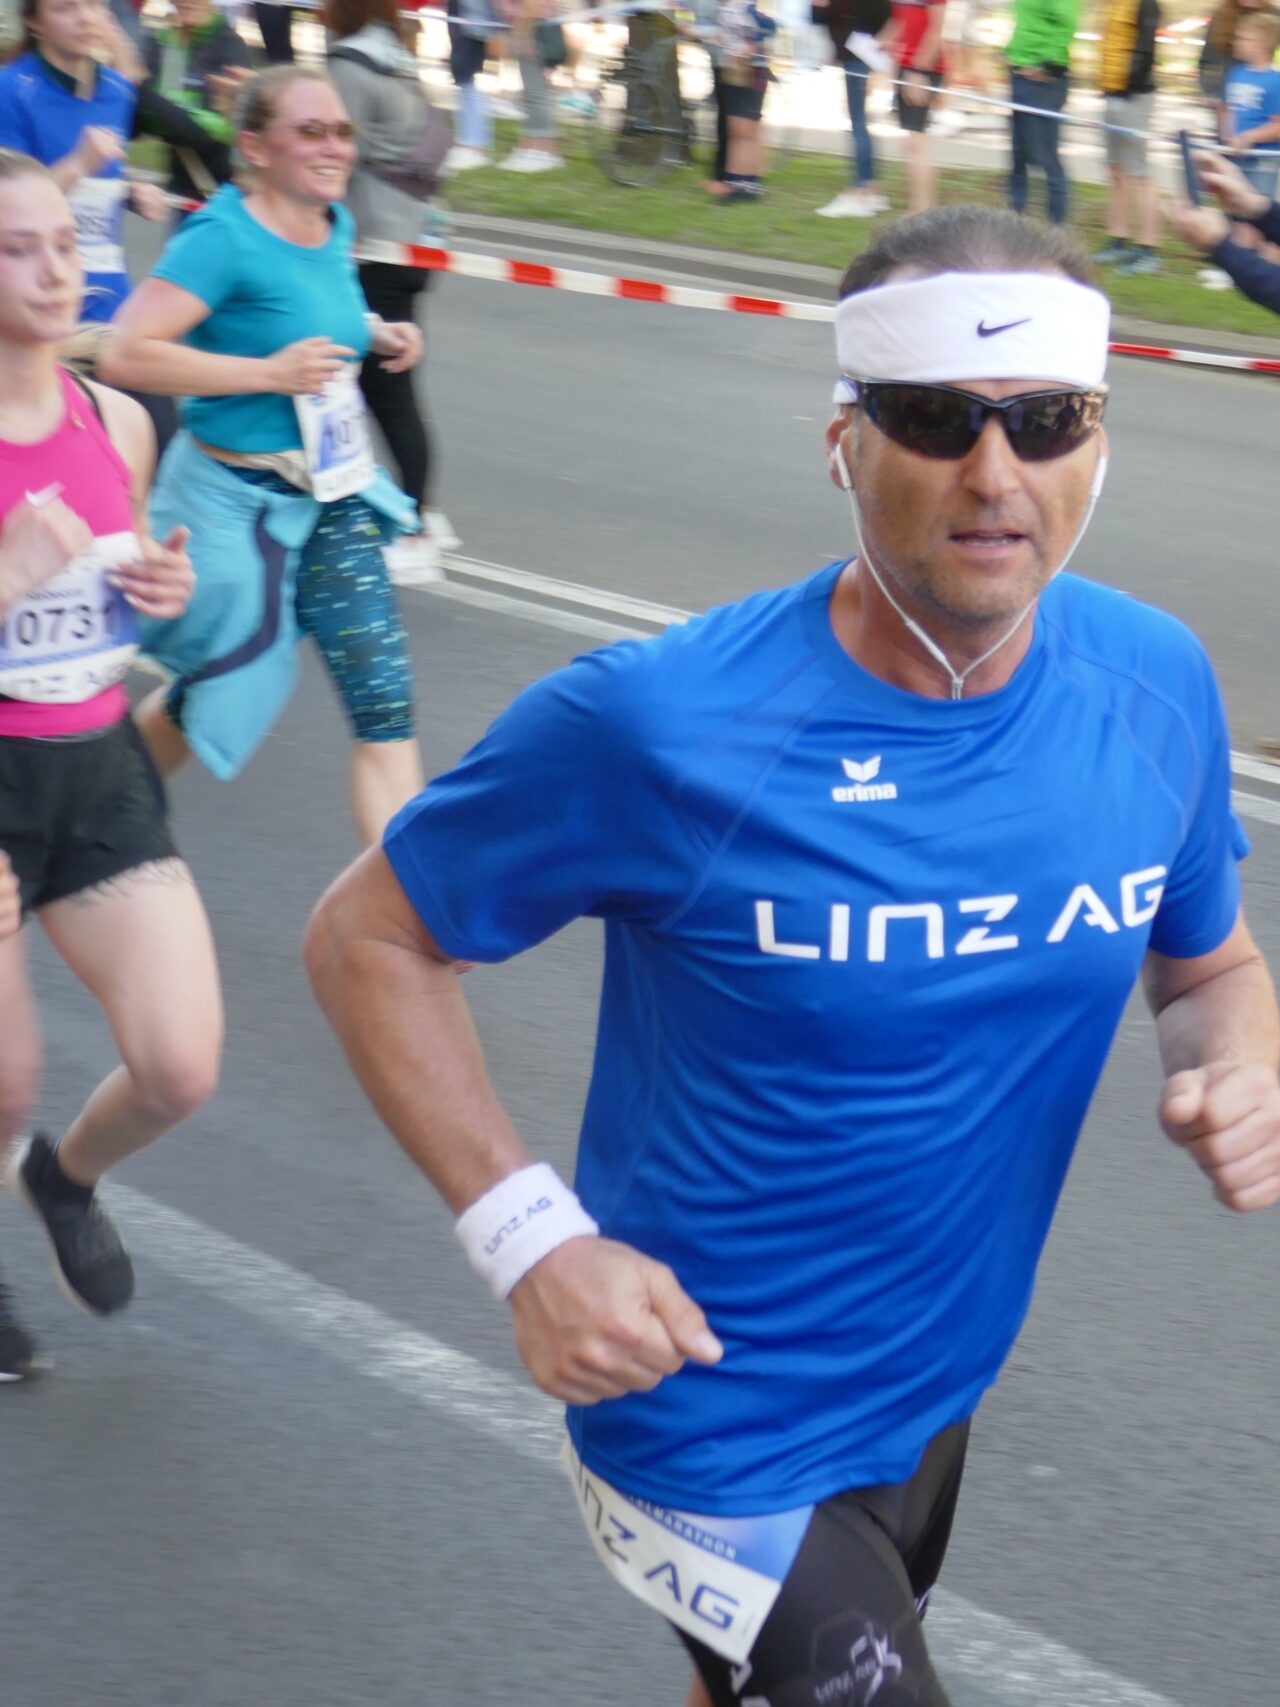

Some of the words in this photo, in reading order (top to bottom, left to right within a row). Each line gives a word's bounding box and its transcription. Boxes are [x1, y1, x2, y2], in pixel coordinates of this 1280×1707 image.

[832, 783, 897, 802] erima
[755, 894, 1019, 962] LINZ
[1046, 865, 1168, 943] AG
[526, 1196, 553, 1219] AG
[644, 1561, 741, 1630] AG
